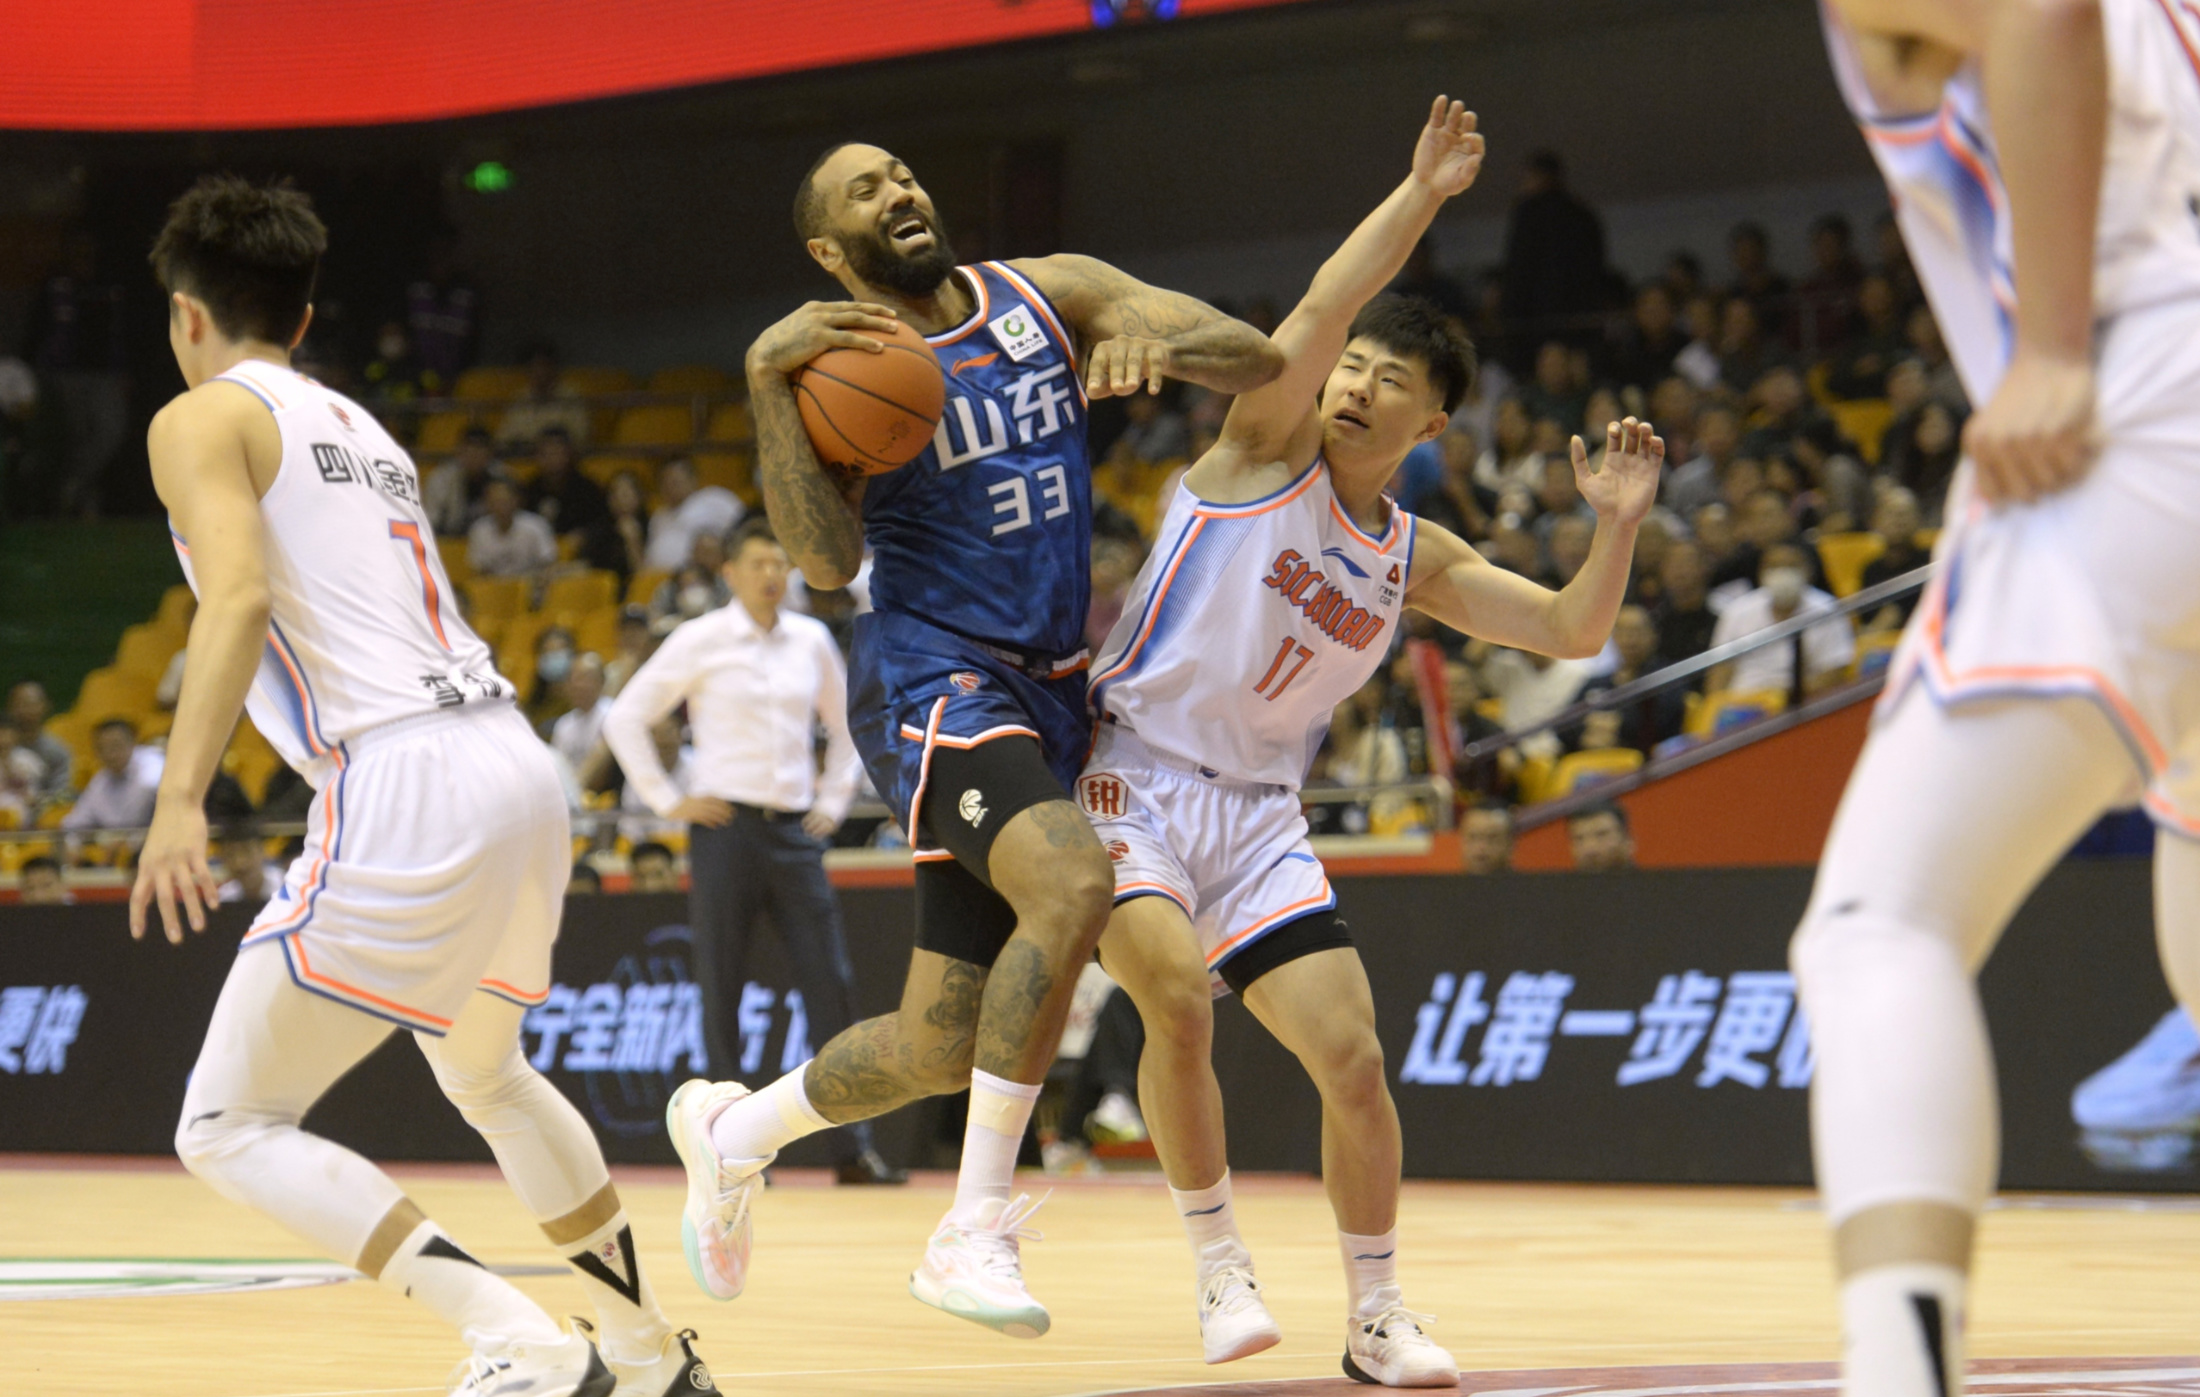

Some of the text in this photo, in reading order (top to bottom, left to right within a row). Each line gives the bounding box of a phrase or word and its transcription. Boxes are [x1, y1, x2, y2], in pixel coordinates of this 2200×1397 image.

[933, 363, 1076, 471] 山东
[986, 464, 1071, 537] 33
[388, 518, 453, 652] 7
[1262, 549, 1385, 652] SICHUAN
[1253, 636, 1315, 701] 17
[0, 984, 89, 1075] 更快
